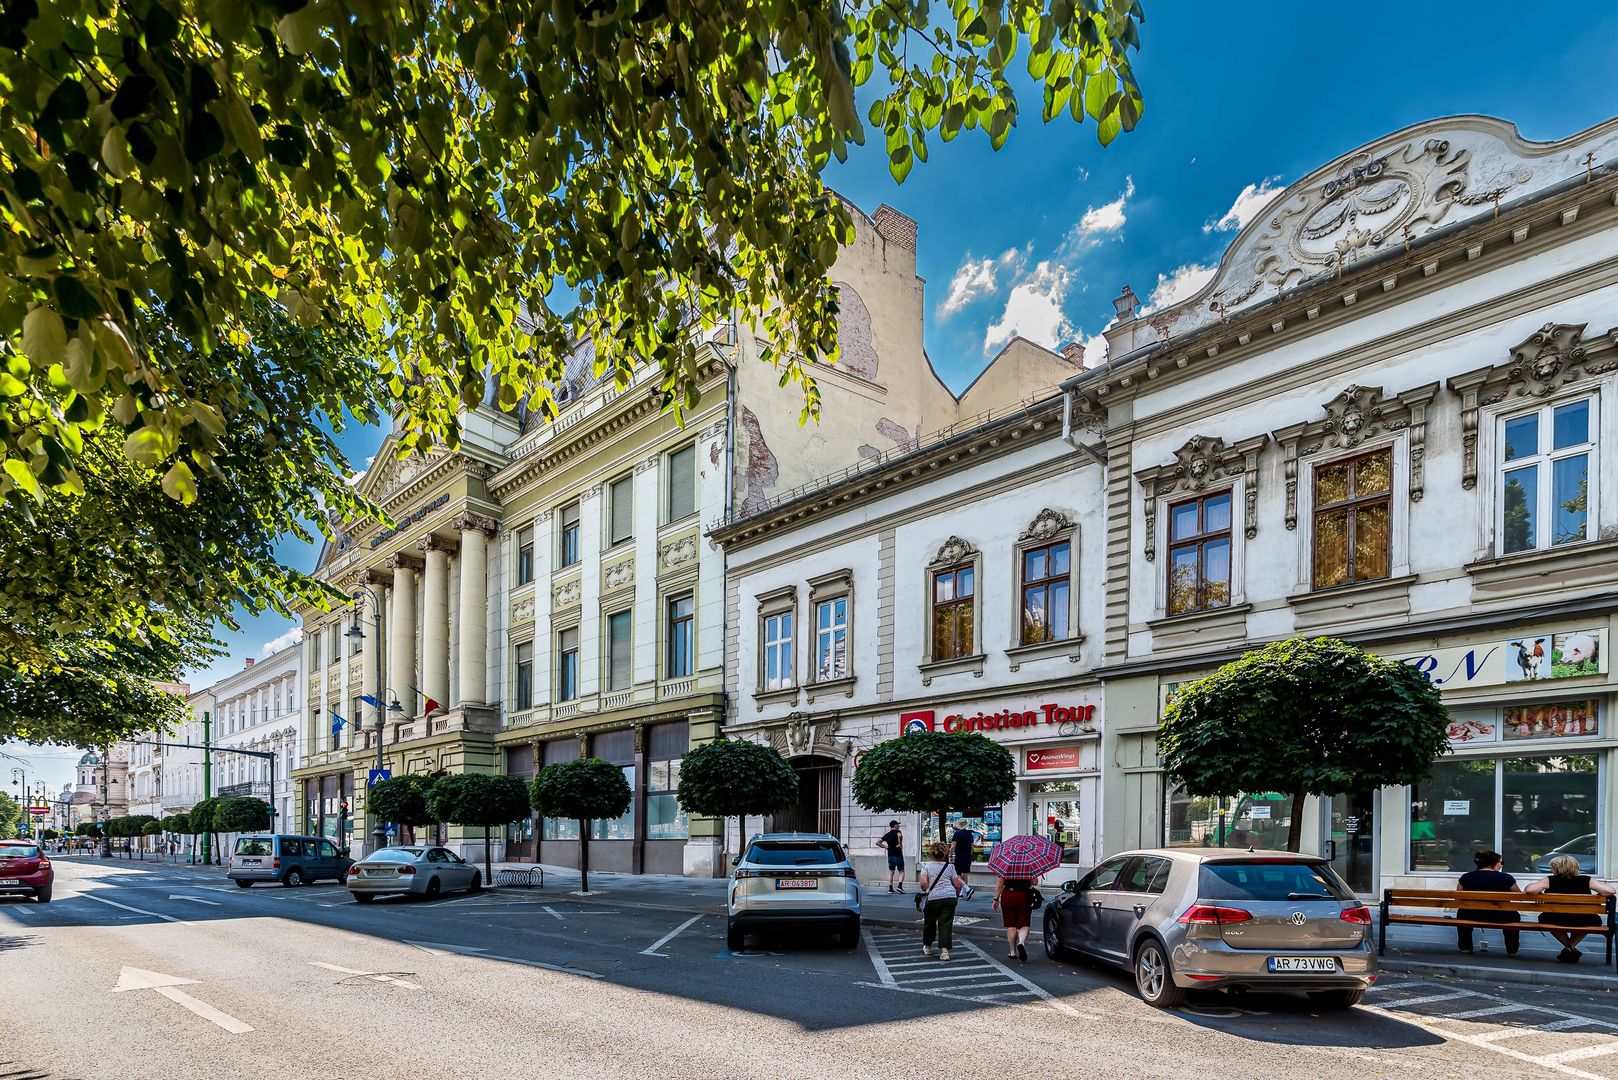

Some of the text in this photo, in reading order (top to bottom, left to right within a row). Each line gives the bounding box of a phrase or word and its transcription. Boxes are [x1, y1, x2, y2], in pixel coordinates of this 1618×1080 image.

[1040, 703, 1096, 724] Tour
[780, 880, 790, 888] AR
[1276, 958, 1334, 970] AR 73VWG
